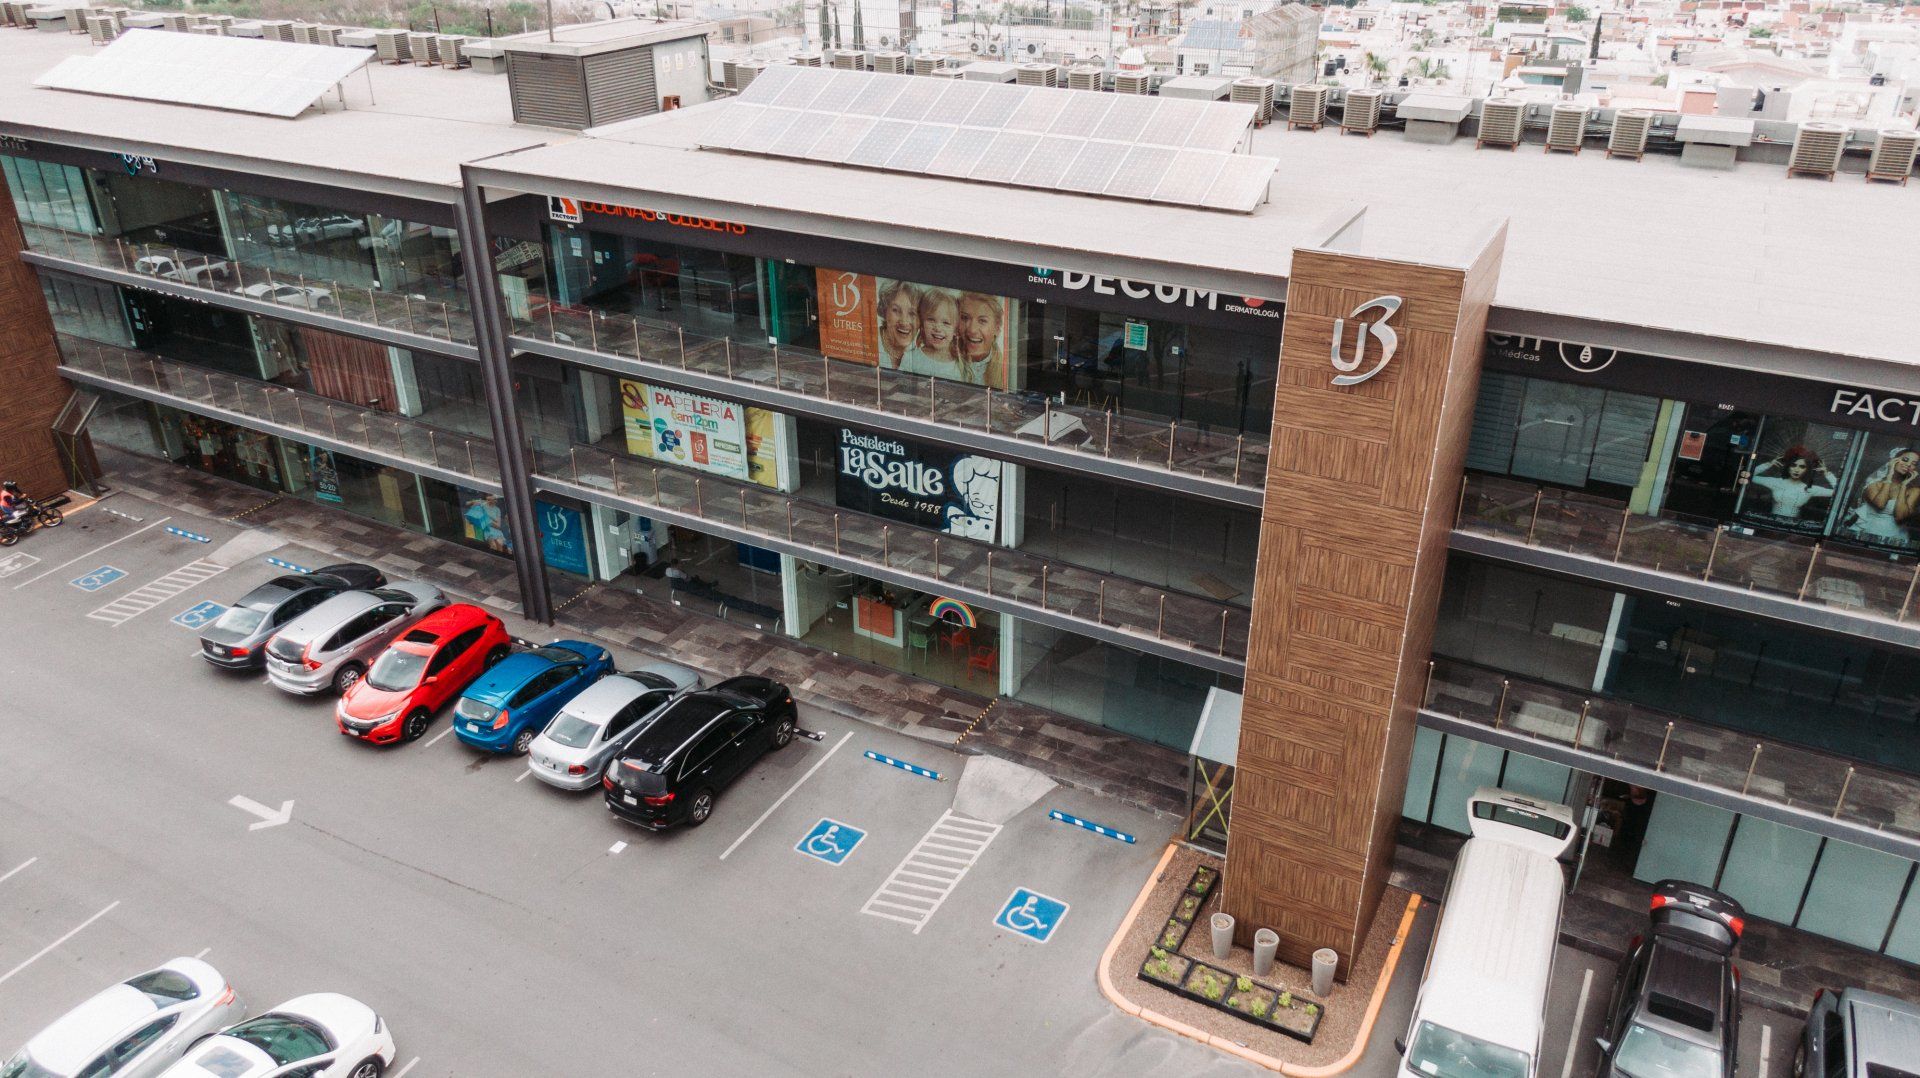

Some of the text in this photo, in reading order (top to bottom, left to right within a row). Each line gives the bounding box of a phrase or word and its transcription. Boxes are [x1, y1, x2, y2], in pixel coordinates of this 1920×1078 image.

[1028, 275, 1057, 286] DENTAL
[1225, 304, 1280, 319] DERMATOLOGÍA
[833, 318, 863, 332] UTRES
[841, 428, 905, 456] Pastelería
[880, 492, 942, 515] Desde 1988
